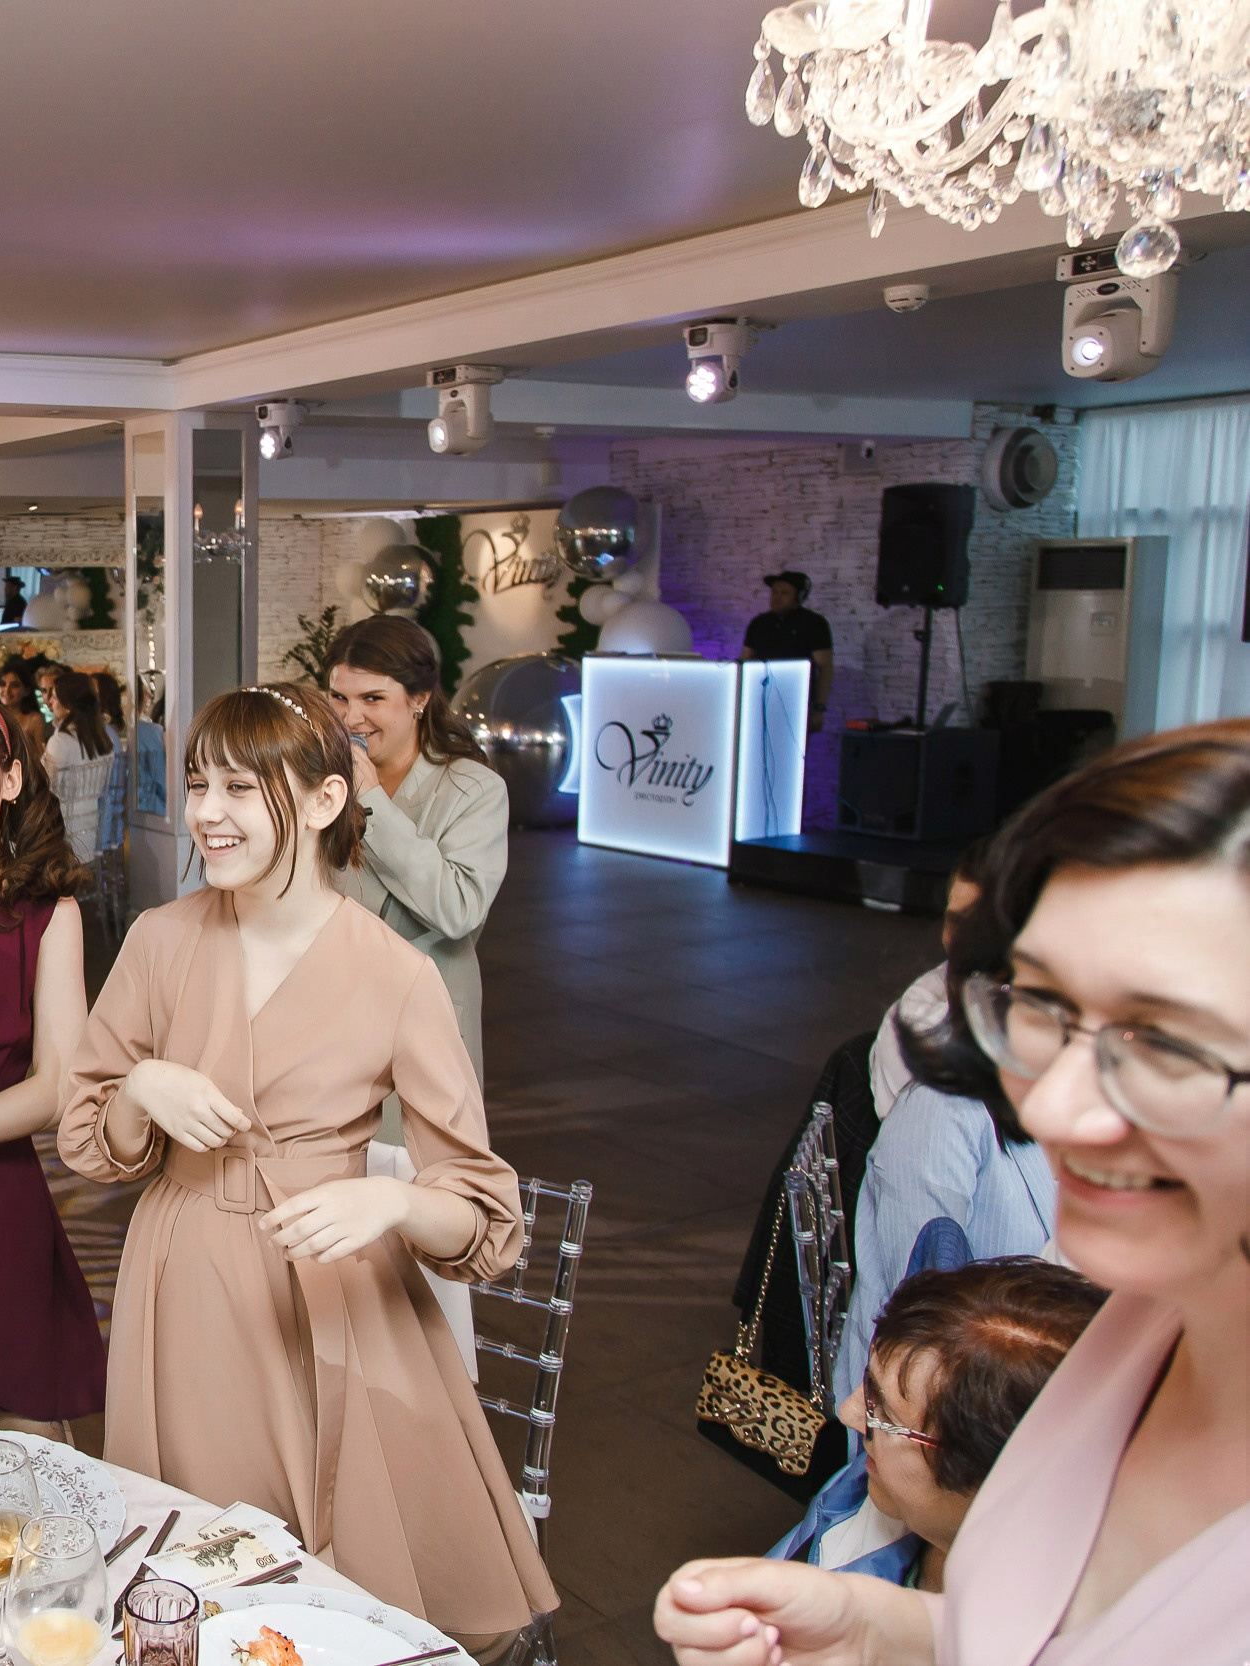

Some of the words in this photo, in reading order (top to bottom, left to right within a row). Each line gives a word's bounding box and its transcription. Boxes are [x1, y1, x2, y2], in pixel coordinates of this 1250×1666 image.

[462, 529, 561, 600] Vin
[595, 720, 714, 807] Vinity
[255, 1553, 278, 1568] 100
